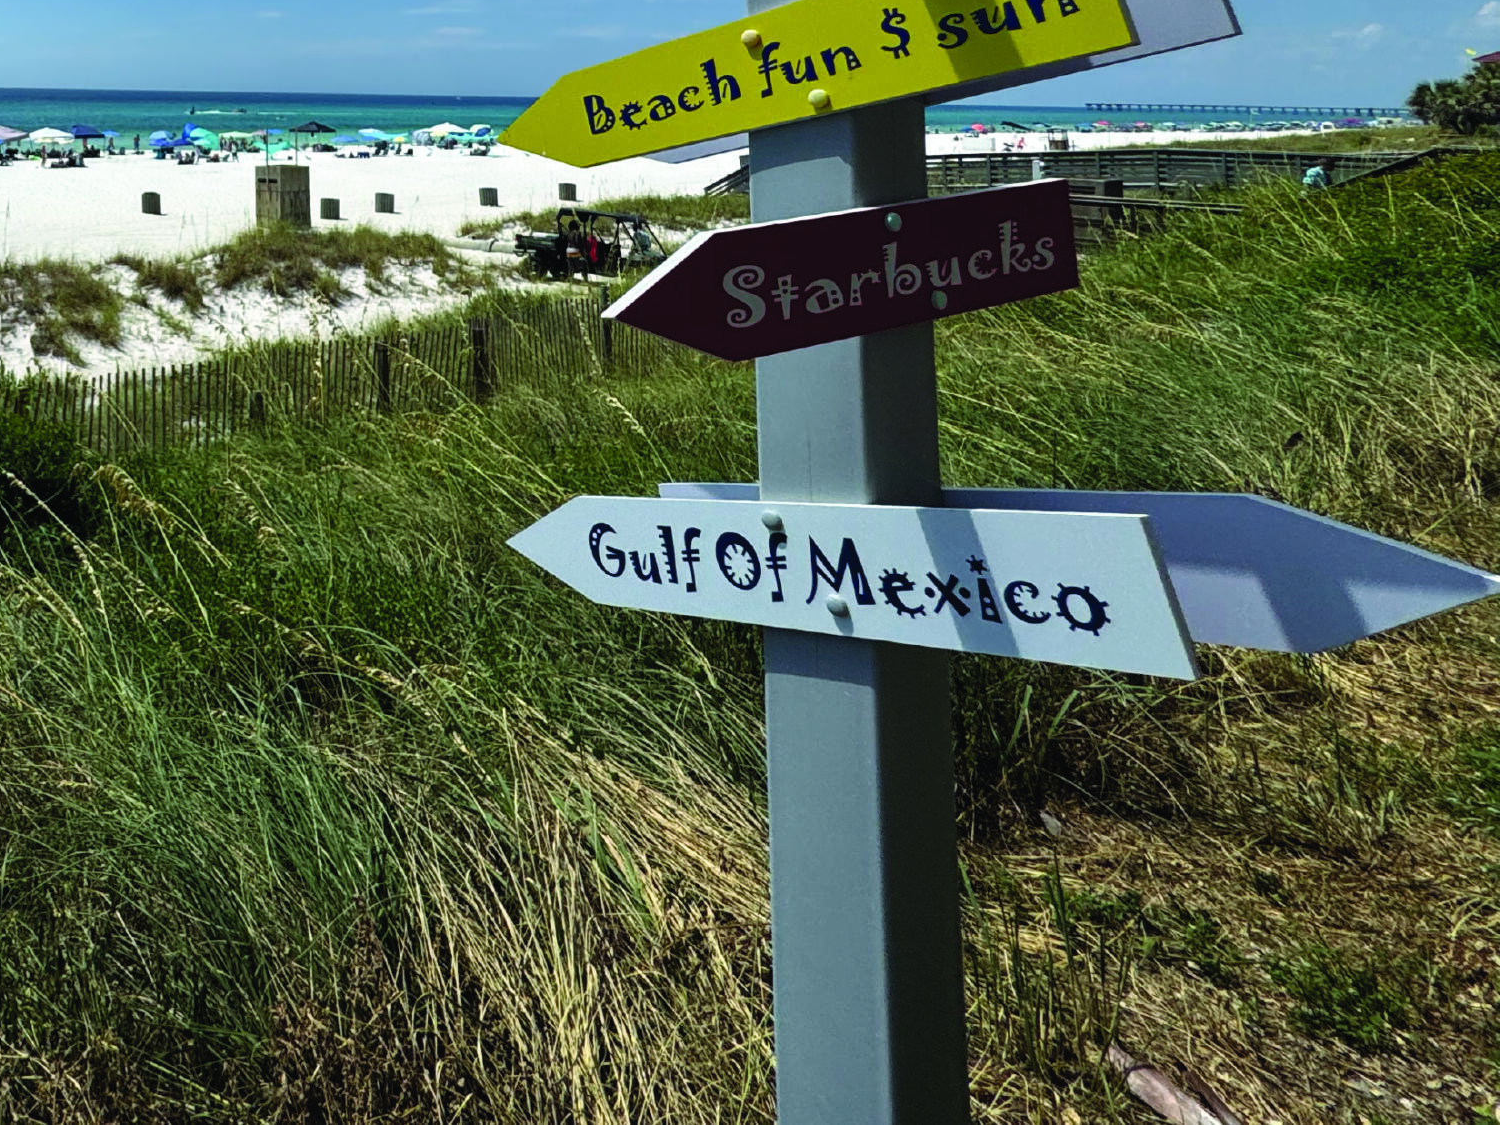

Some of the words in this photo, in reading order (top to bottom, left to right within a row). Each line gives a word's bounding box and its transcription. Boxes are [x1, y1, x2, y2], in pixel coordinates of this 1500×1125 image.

[583, 59, 741, 135] Beach
[758, 41, 861, 98] fun
[880, 8, 910, 59] $
[722, 219, 1056, 329] Starbucks
[588, 522, 703, 593] Gulf
[715, 529, 787, 603] Of
[806, 536, 1111, 636] Mexico
